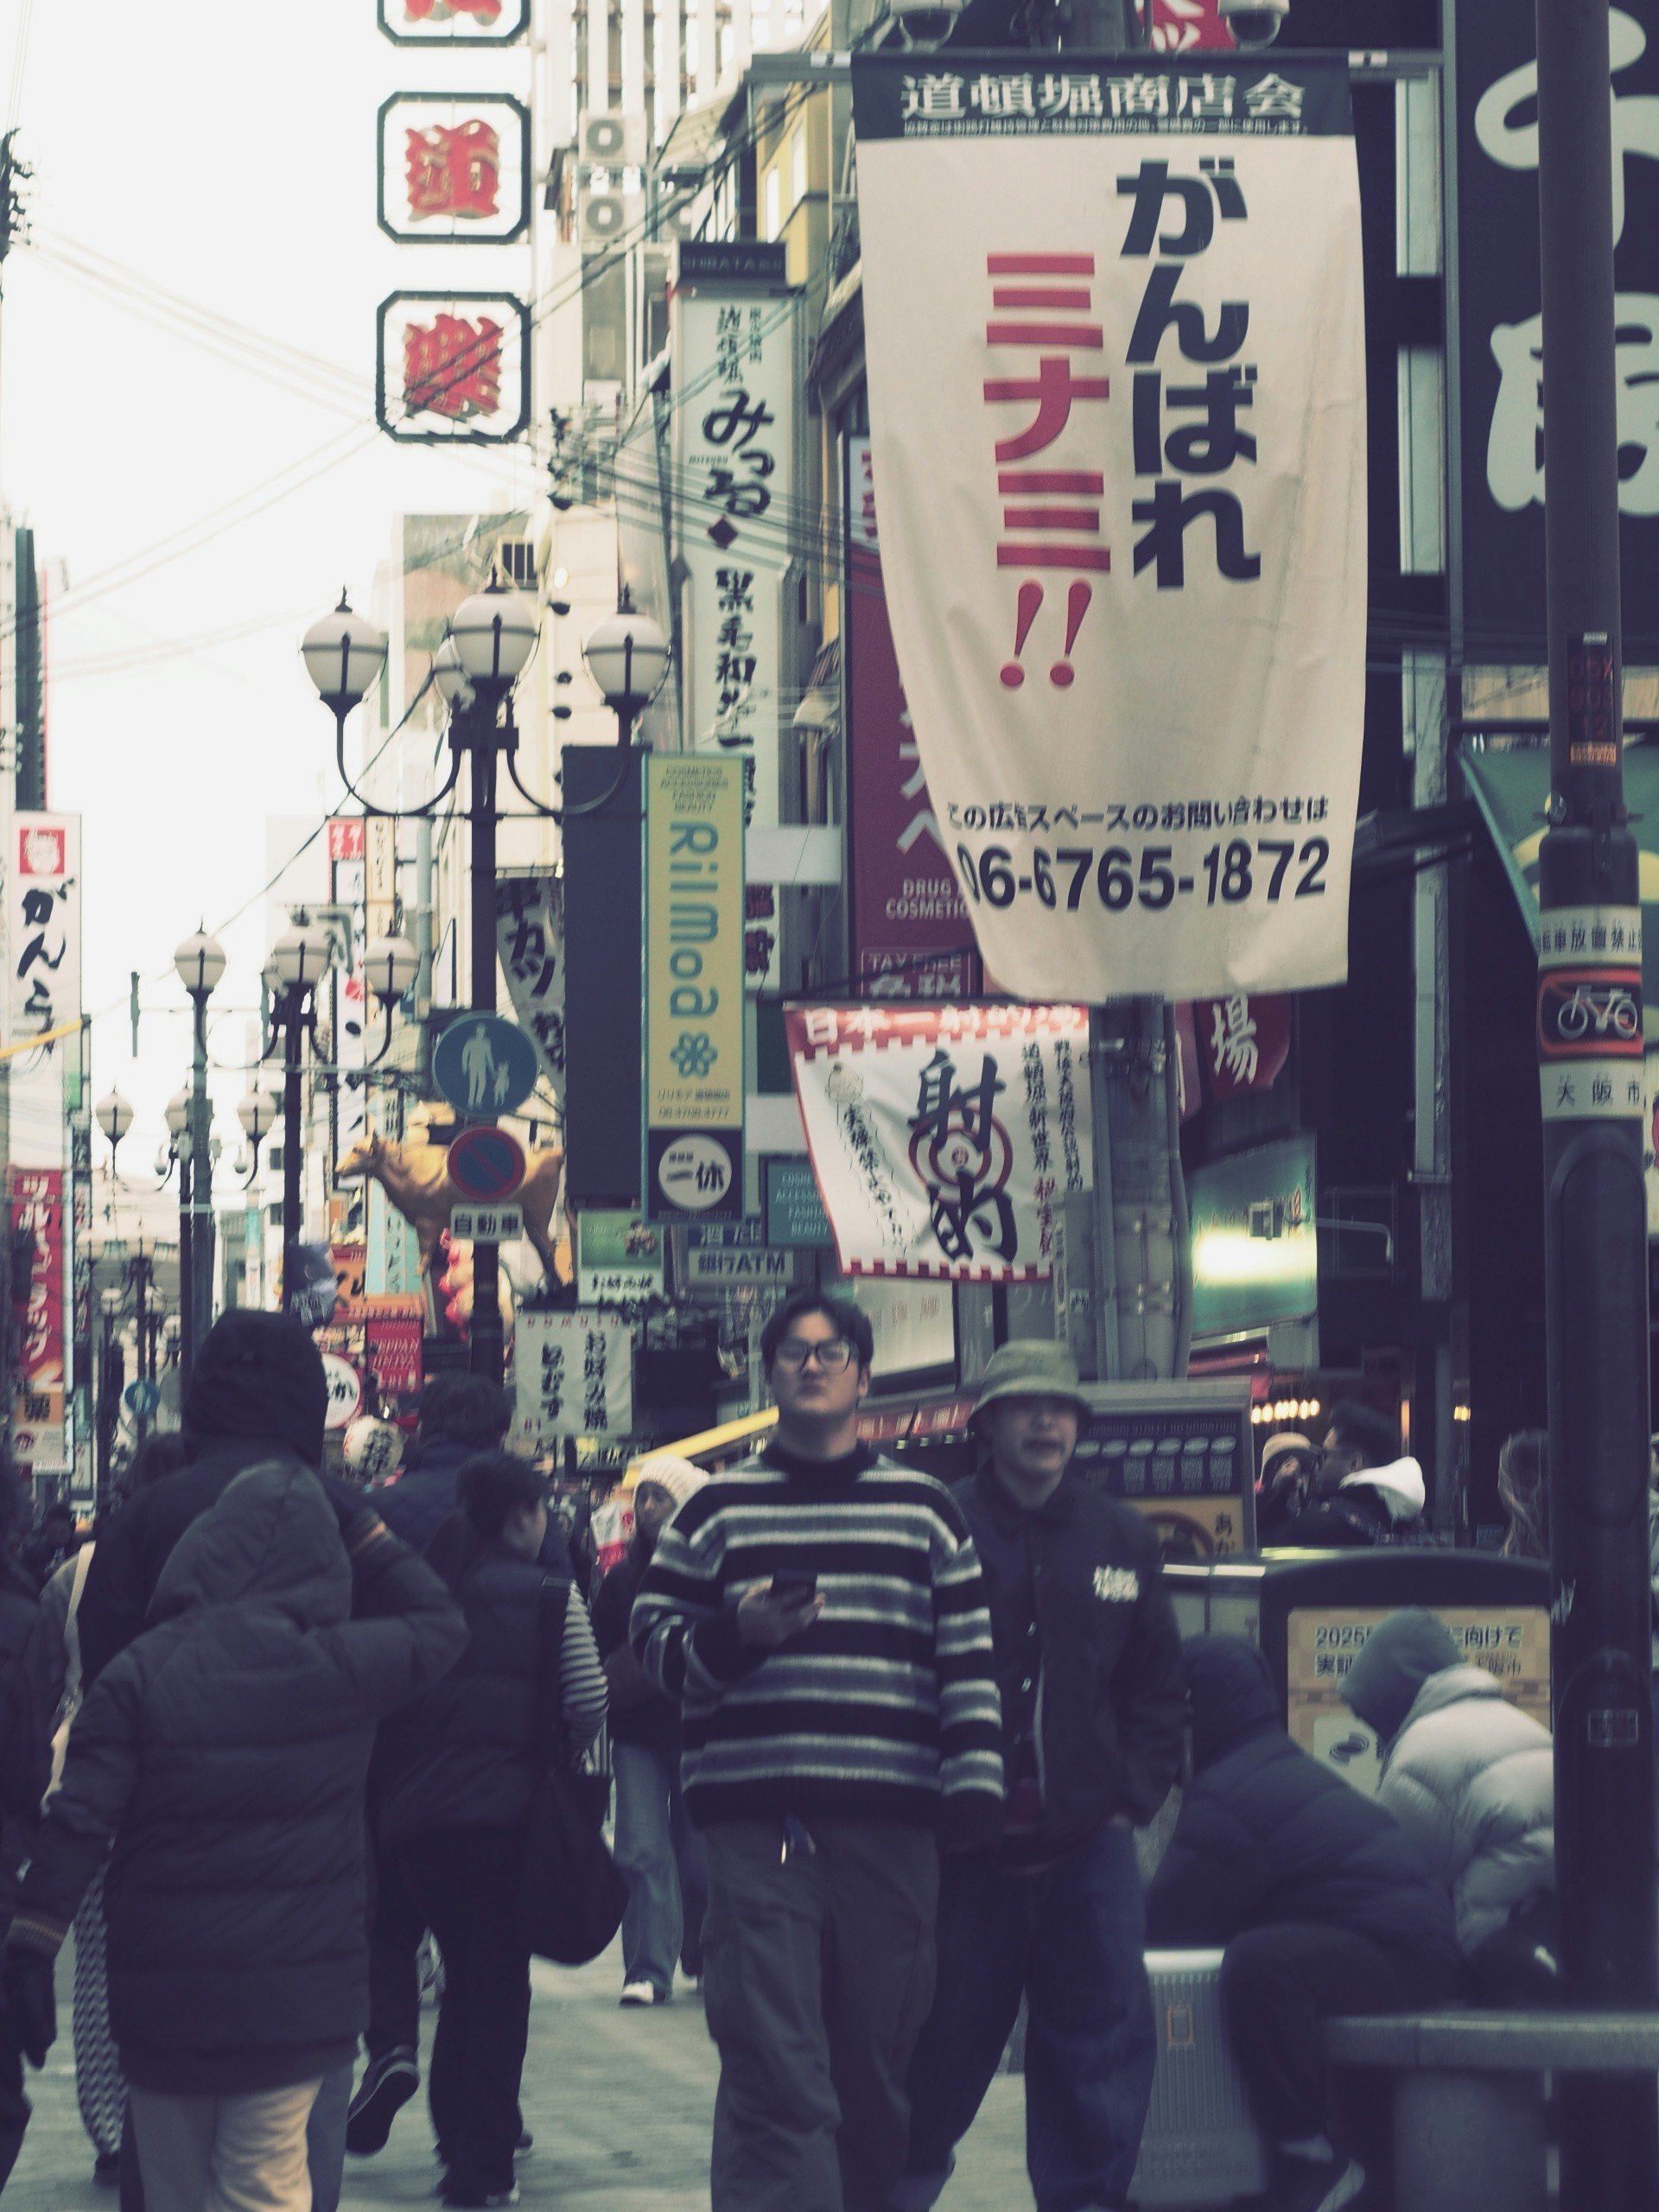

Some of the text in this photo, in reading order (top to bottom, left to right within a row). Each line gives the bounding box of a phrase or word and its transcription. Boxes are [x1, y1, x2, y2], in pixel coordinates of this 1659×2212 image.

[901, 72, 1306, 119] 道頓堀商店会
[1116, 156, 1261, 591] がんばれ
[903, 877, 951, 899] DRUG
[957, 836, 1331, 912] 06-6765-1872
[886, 899, 969, 919] COSMETIC
[1556, 1077, 1640, 1108] 大阪市
